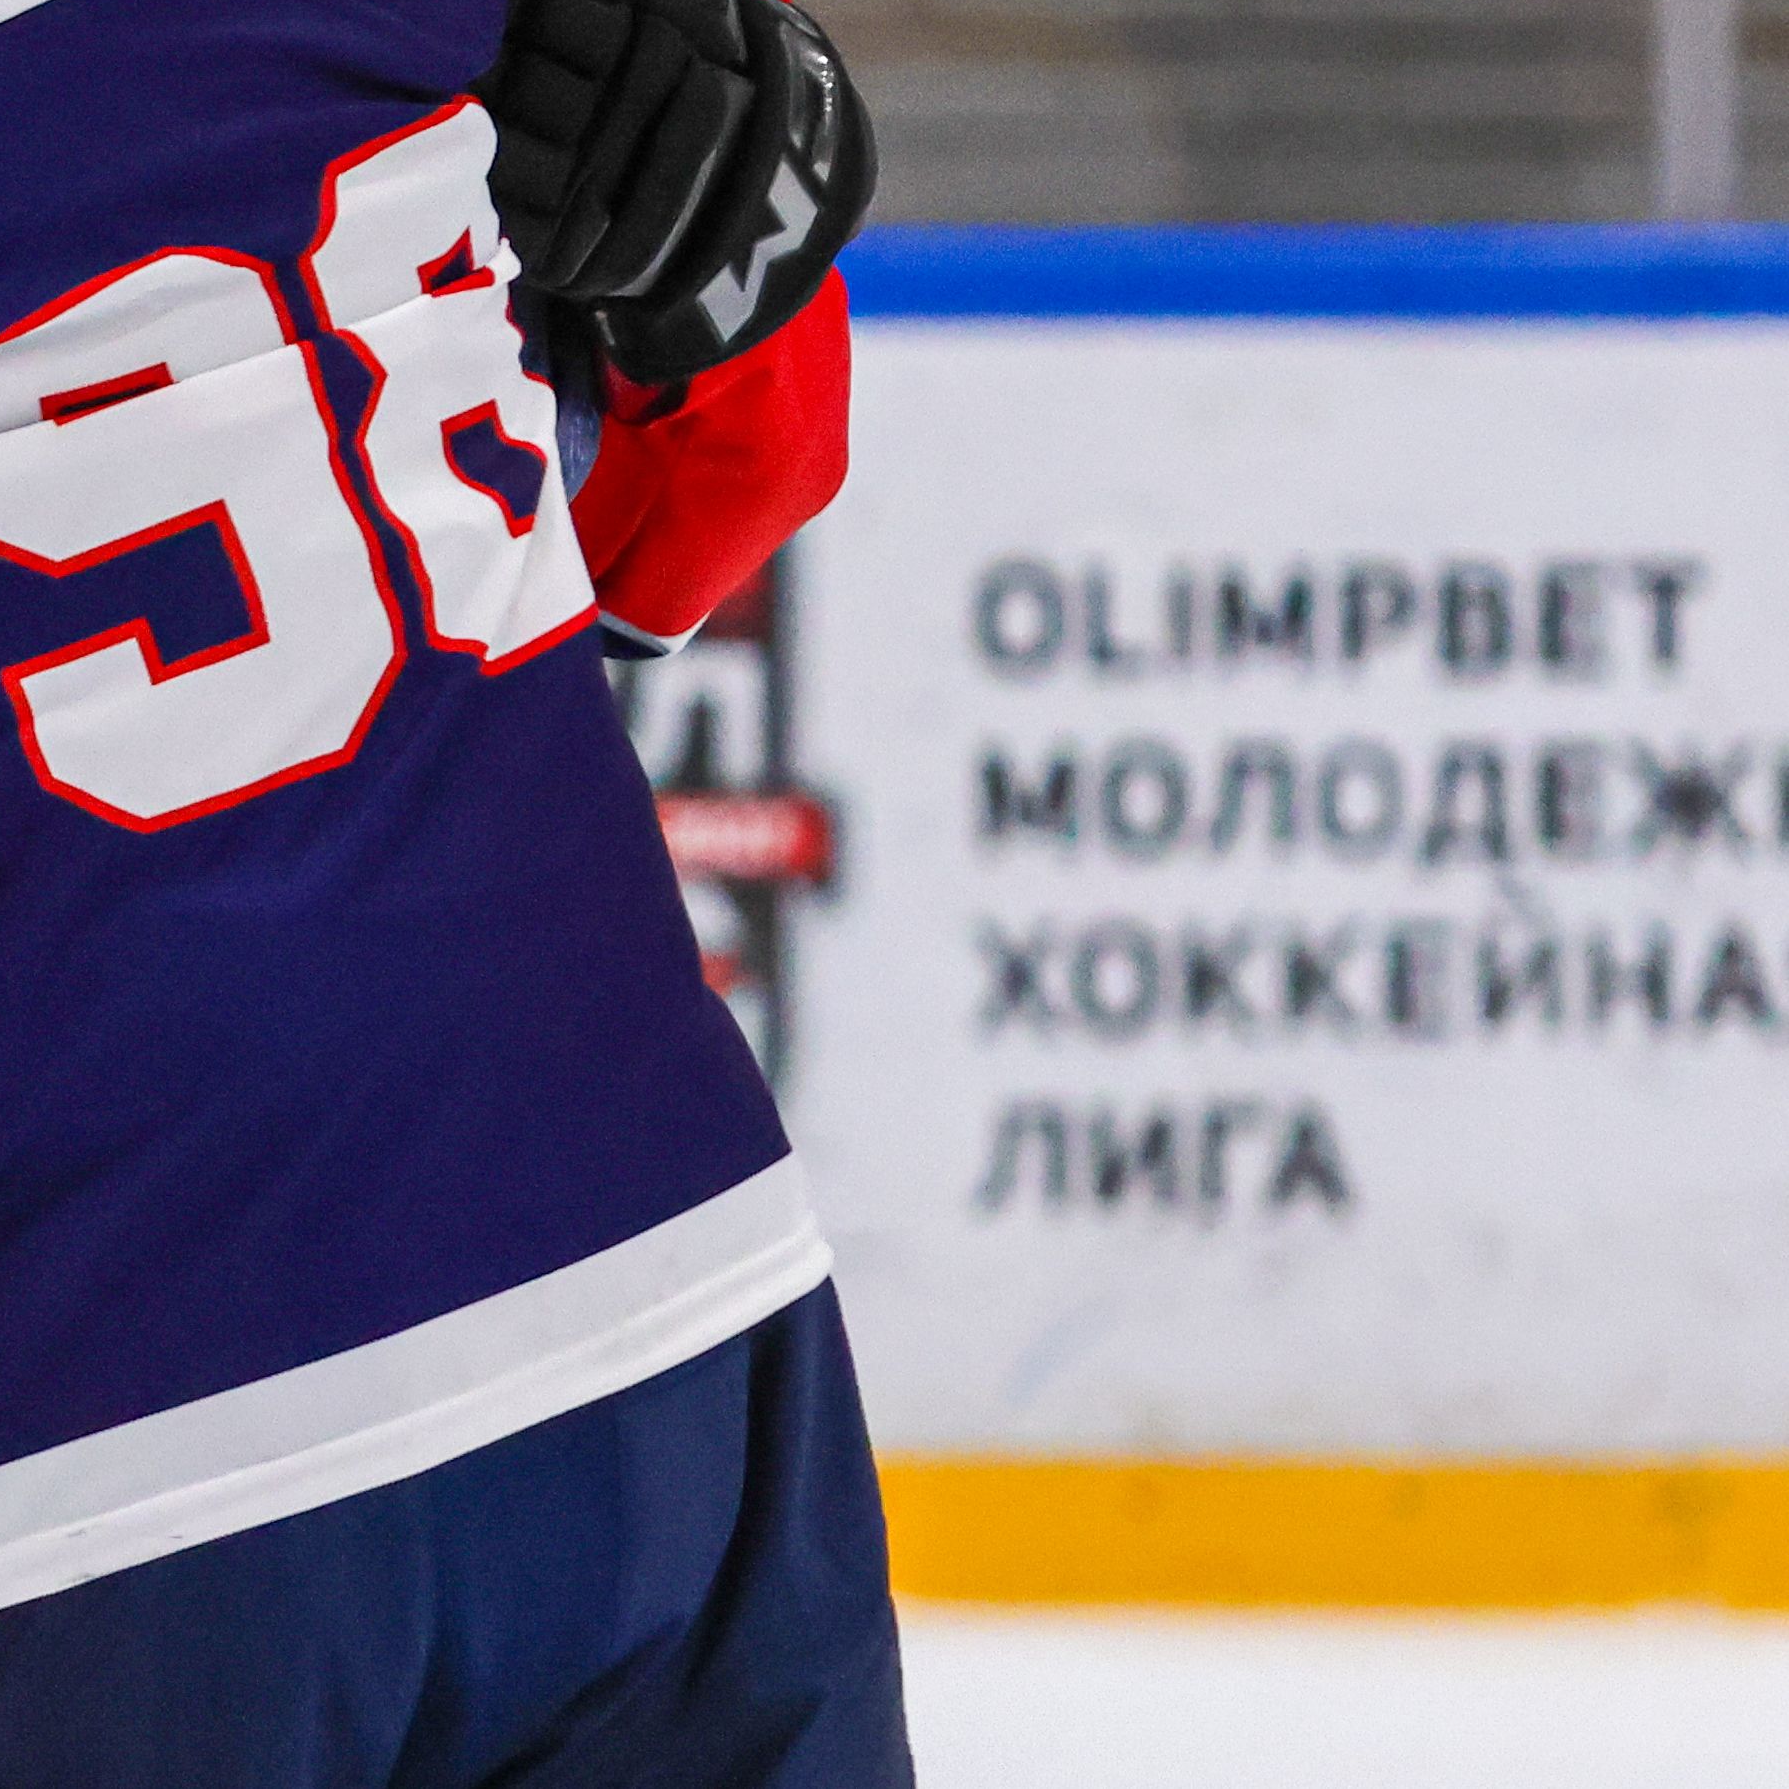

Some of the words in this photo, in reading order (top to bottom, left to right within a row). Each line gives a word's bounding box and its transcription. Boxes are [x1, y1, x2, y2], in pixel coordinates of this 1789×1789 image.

[973, 556, 1705, 677] OLIMPBET
[977, 739, 1789, 866] МОЛОДЕЖ
[973, 1099, 1354, 1211] ЛИГА
